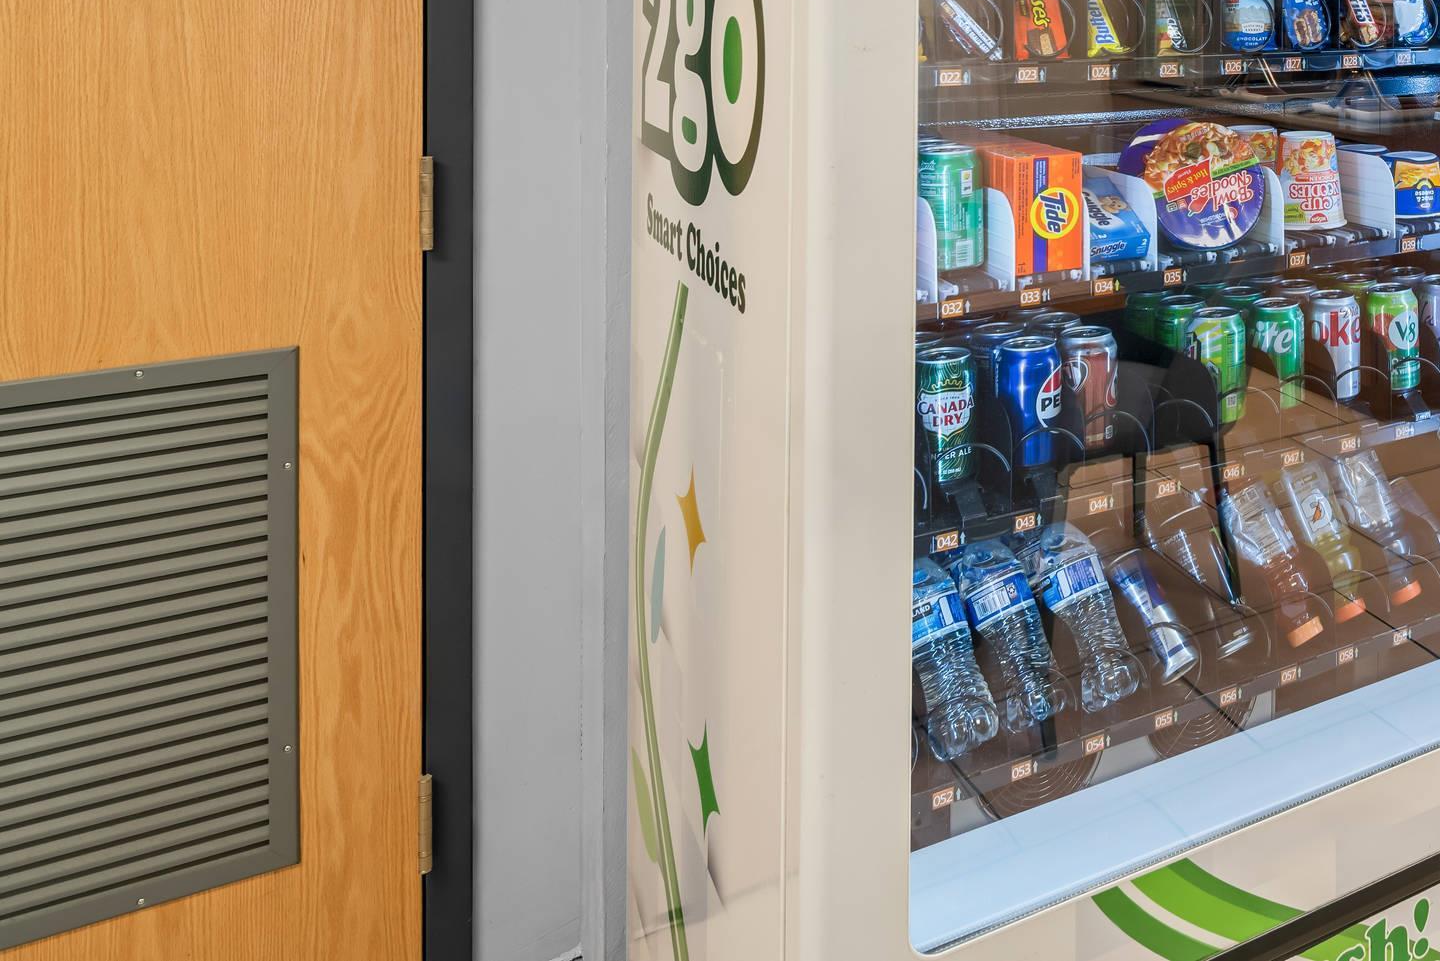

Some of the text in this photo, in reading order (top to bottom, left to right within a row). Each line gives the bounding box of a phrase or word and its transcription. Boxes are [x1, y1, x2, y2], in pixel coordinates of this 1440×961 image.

[1225, 62, 1241, 72] 026
[1286, 59, 1300, 69] 027
[1344, 56, 1357, 66] 028
[1018, 69, 1037, 80] 023
[1092, 67, 1110, 78] 024
[1161, 64, 1177, 74] 025
[940, 72, 961, 83] 022
[1196, 168, 1209, 180] Hot
[1167, 180, 1187, 194] Spicy
[1191, 170, 1253, 200] Noodles
[1289, 181, 1340, 199] NOODLES
[1212, 187, 1254, 212] Bowl
[1300, 196, 1333, 211] CUP
[1039, 192, 1068, 234] Tide
[1090, 240, 1128, 257] Snuggle
[1402, 240, 1416, 250] 039
[647, 193, 746, 314] Smart Choices
[1290, 255, 1305, 266] 037
[1164, 272, 1181, 283] 035
[1095, 281, 1113, 293] 034
[1021, 292, 1040, 303] 033
[942, 302, 962, 315] 032
[1252, 320, 1294, 354] ite
[917, 395, 974, 415] CANADA
[932, 411, 963, 427] DRY
[958, 446, 972, 457] ALE
[1224, 467, 1240, 478] 046
[1158, 483, 1175, 495] 045
[1089, 498, 1108, 511] 044
[1015, 515, 1035, 528] 043
[937, 534, 958, 548] 042
[912, 605, 931, 617] LAND
[1339, 650, 1353, 661] 058
[1282, 671, 1297, 682] 057
[1220, 691, 1236, 704] 056
[1155, 713, 1172, 726] 055
[1086, 739, 1104, 752] 054
[1012, 764, 1031, 778] 053
[932, 790, 954, 805] 052
